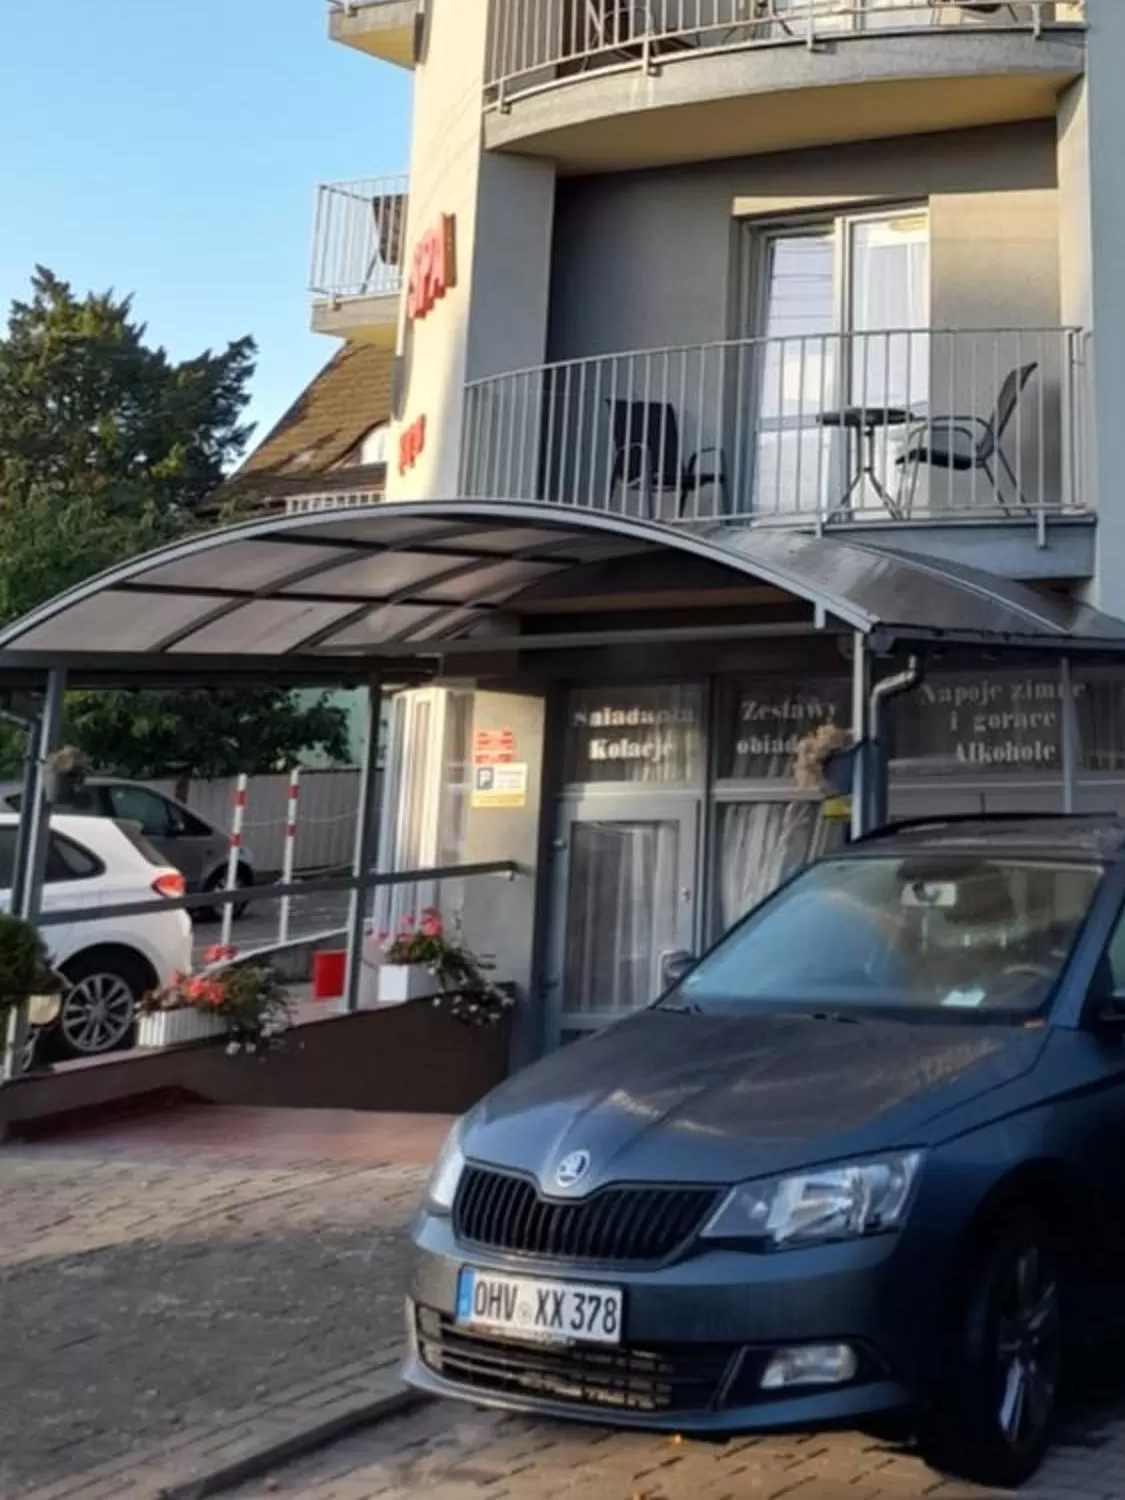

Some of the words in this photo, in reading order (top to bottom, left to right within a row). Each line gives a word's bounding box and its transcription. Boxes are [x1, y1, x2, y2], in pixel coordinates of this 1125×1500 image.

[474, 1280, 518, 1321] OHV
[535, 1288, 566, 1329] XX
[570, 1292, 617, 1334] 378
